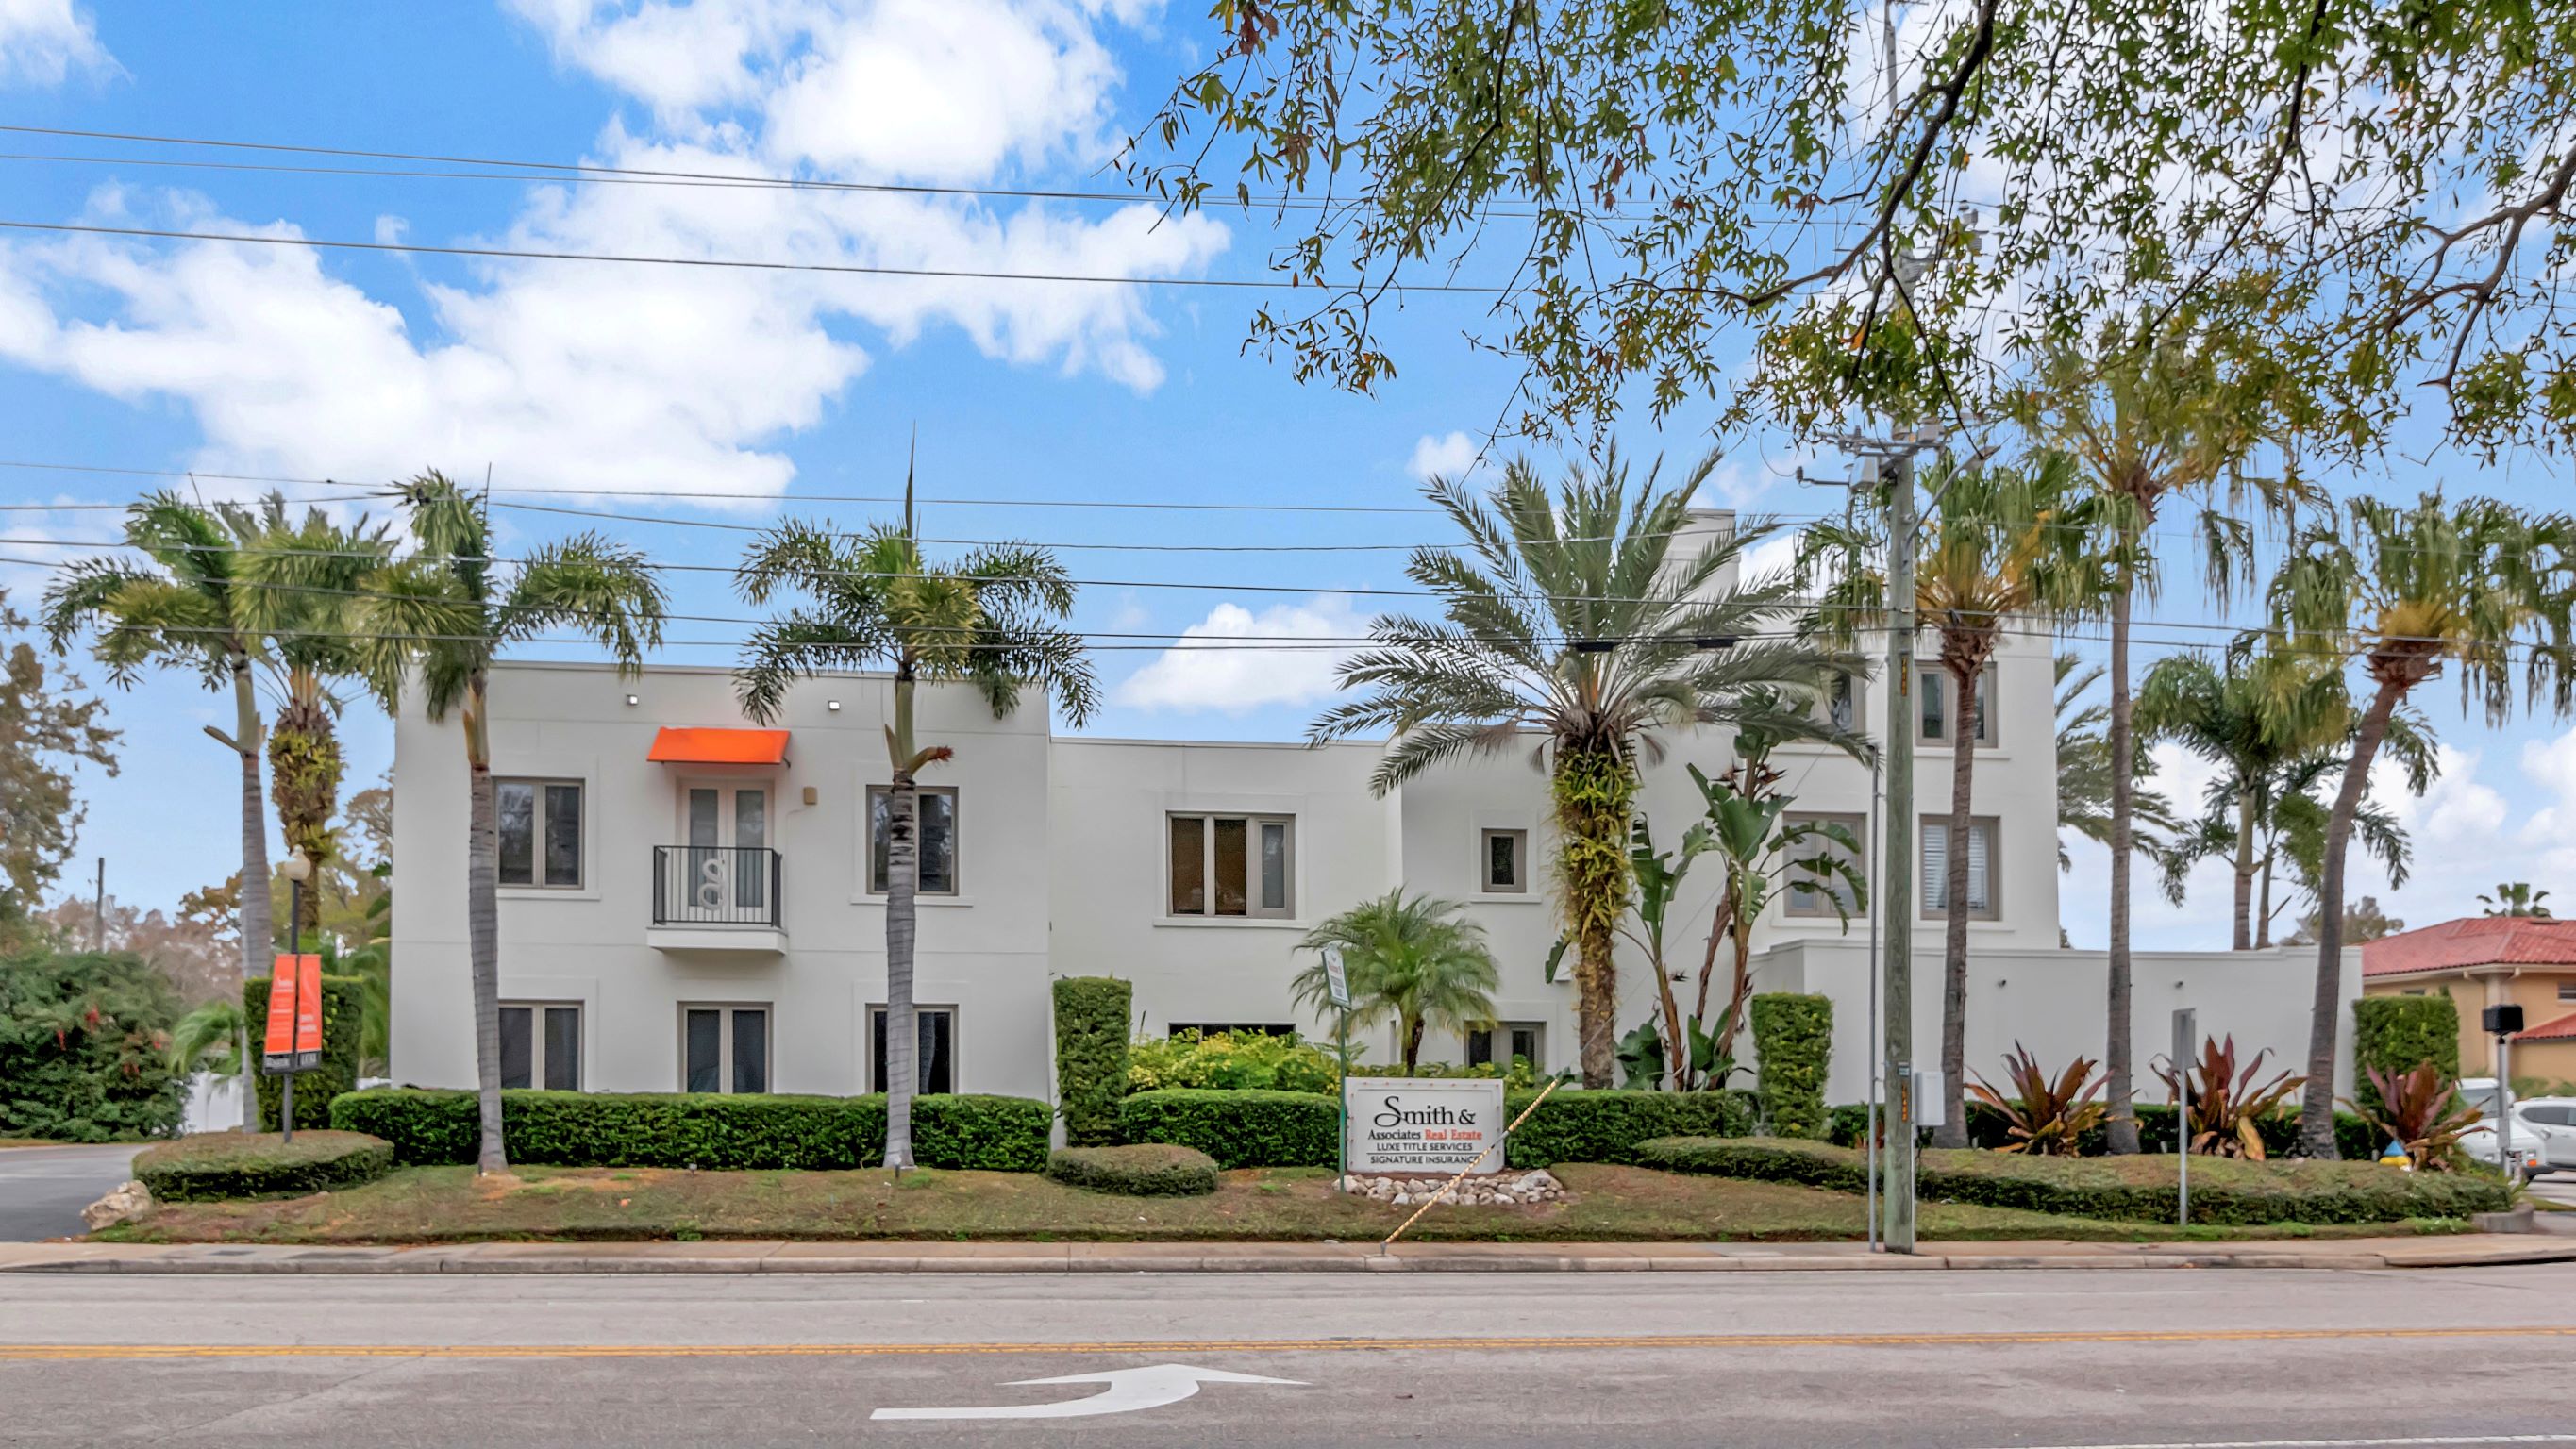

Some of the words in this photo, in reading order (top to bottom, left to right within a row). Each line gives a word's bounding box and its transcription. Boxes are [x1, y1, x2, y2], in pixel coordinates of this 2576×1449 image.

[1374, 1095, 1455, 1128] Smith
[1458, 1108, 1477, 1125] &
[1367, 1129, 1421, 1141] Associates
[1424, 1129, 1447, 1141] Real
[1451, 1129, 1482, 1141] Estate
[1376, 1142, 1400, 1152] LUXE
[1403, 1142, 1428, 1152] TITLE
[1430, 1142, 1473, 1152] SERVICES
[1370, 1155, 1423, 1164] SIGNATURE
